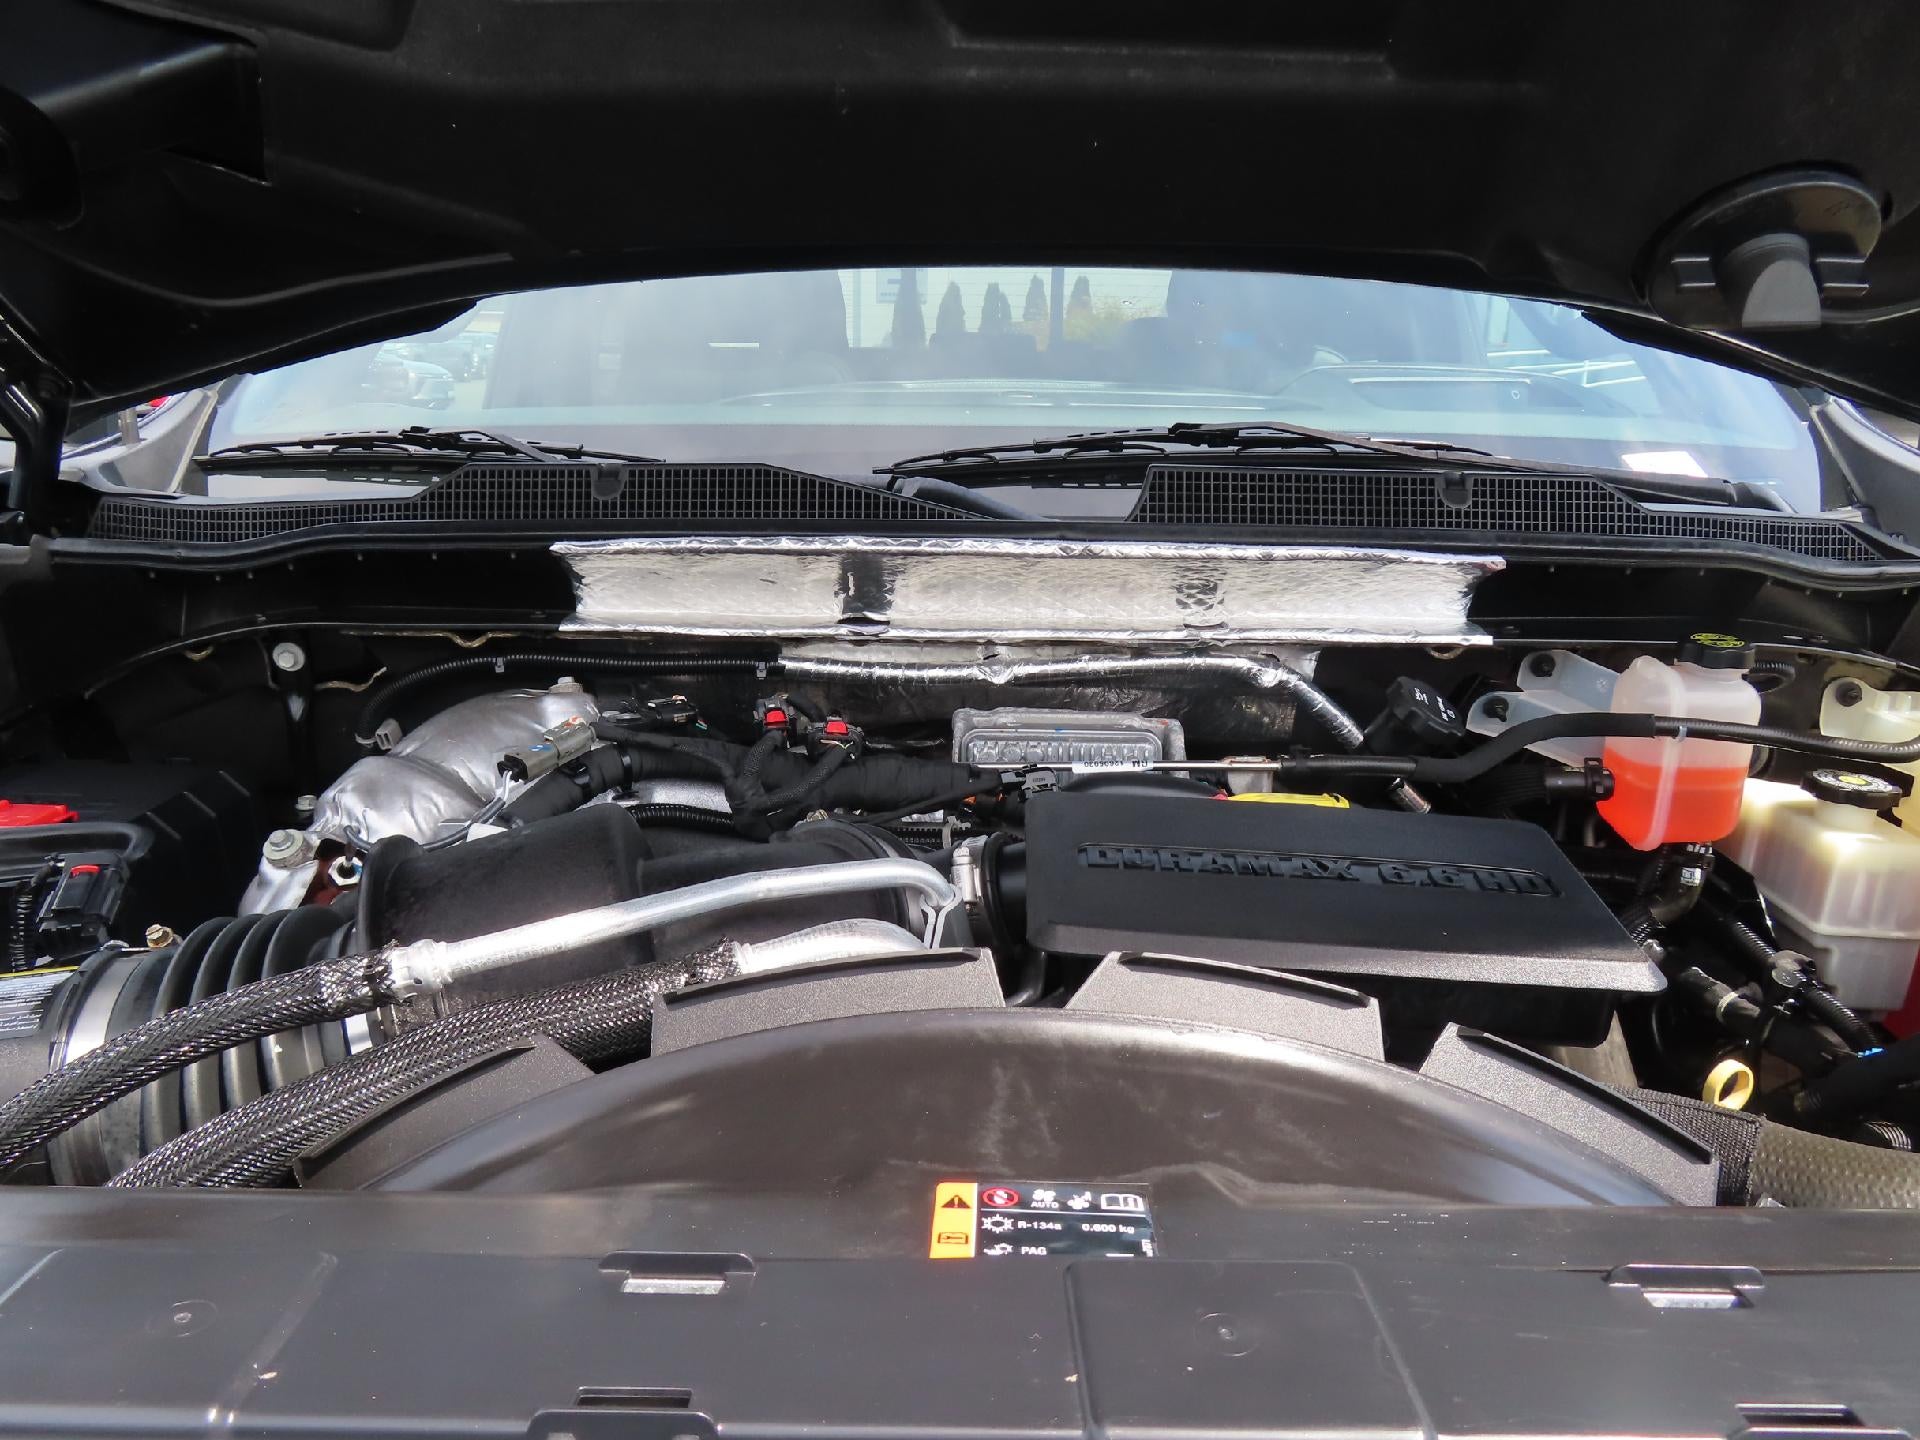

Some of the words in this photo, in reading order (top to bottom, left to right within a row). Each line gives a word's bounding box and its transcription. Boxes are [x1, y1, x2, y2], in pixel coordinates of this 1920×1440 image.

[1084, 846, 1360, 882] DURAMAX
[1031, 1200, 1060, 1209] AUTO
[1017, 1220, 1062, 1230] R-134a
[1118, 1224, 1135, 1234] kg
[1021, 1246, 1047, 1256] PAG
